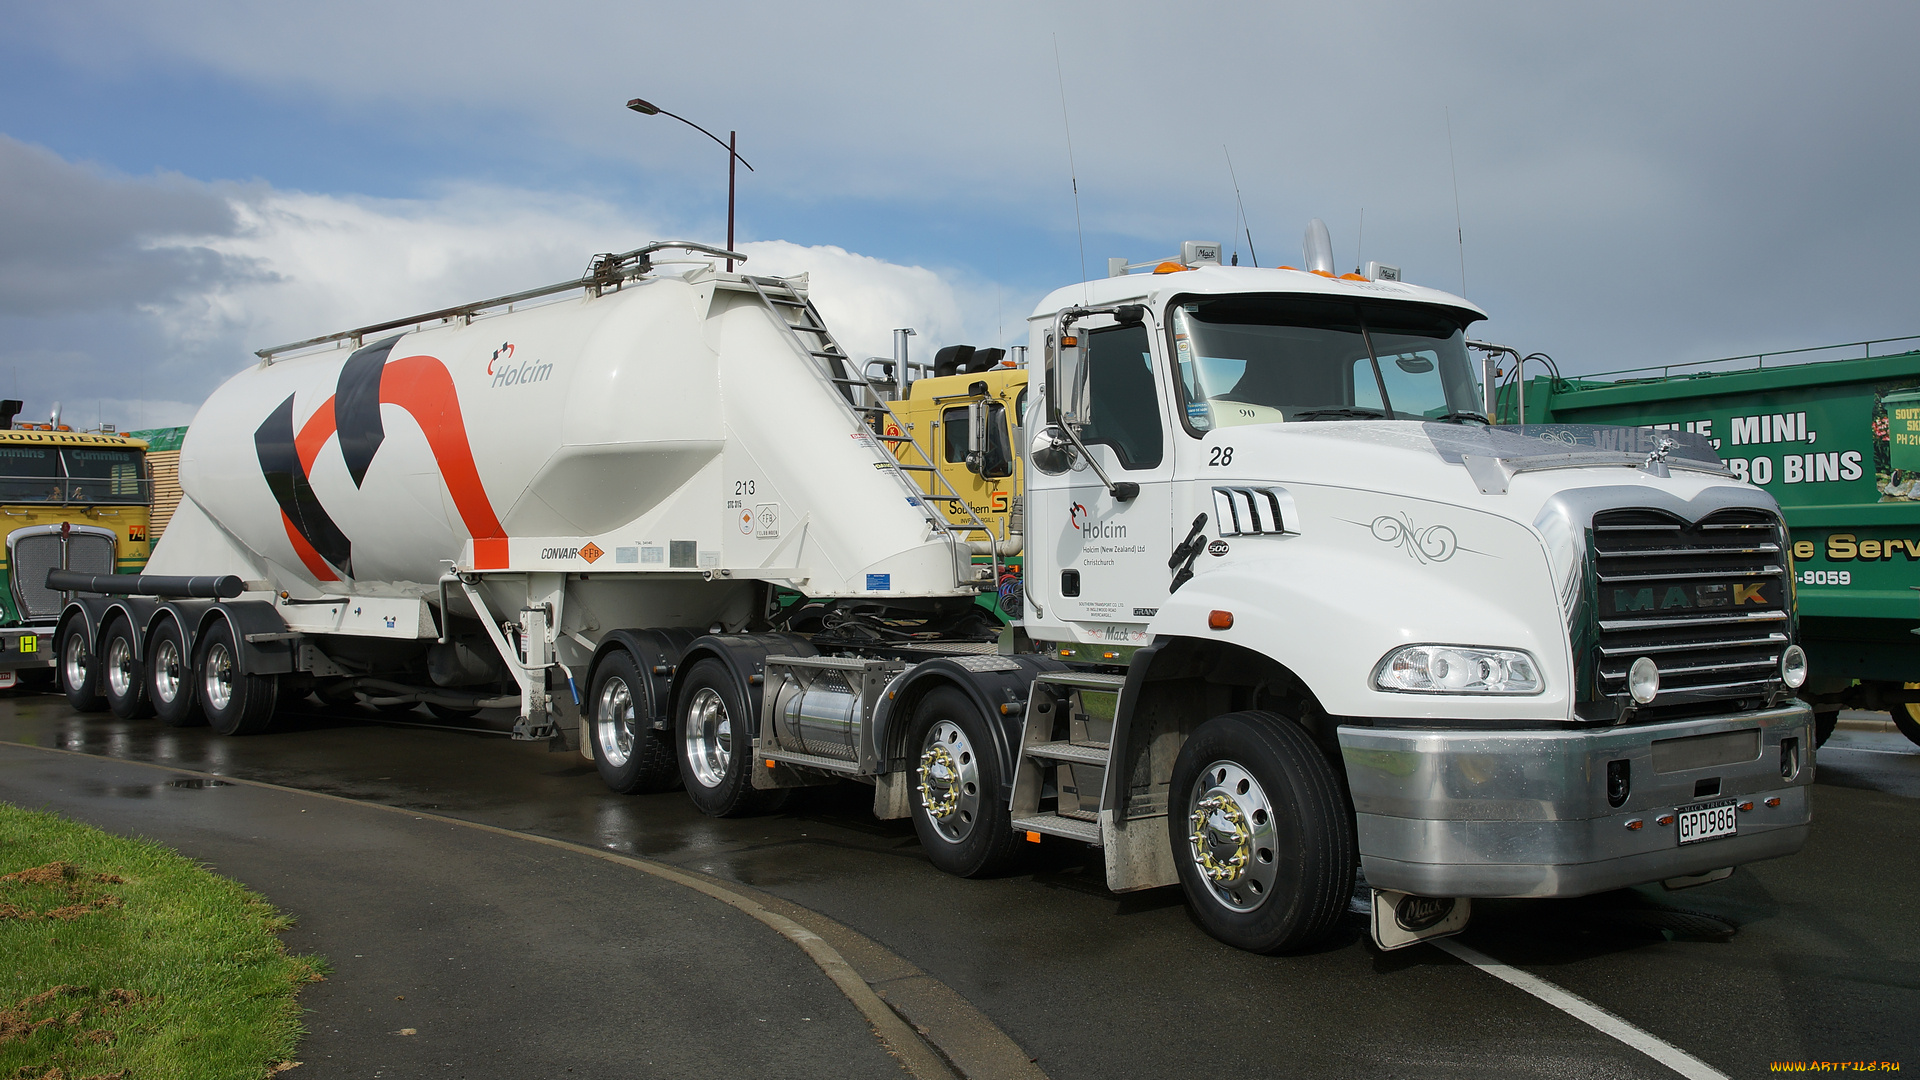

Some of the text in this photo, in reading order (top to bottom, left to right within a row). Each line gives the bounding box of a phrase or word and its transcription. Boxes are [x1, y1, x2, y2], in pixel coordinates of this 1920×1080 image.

[1198, 249, 1215, 258] Mack
[491, 359, 553, 388] Holcim
[1239, 409, 1255, 418] 90
[1896, 408, 1920, 420] SOUT
[1731, 411, 1816, 445] MINI,
[1897, 434, 1908, 445] PH
[0, 448, 45, 459] mmins
[72, 450, 130, 461] Cummins
[1209, 446, 1234, 466] 28
[1783, 450, 1863, 484] BINS
[735, 480, 755, 495] 213
[131, 528, 144, 540] 74
[1083, 521, 1127, 538] Holcim
[541, 547, 578, 559] CONVAIR
[583, 548, 599, 558] FFB
[1100, 546, 1113, 554] (New
[1114, 545, 1136, 554] Zealand)
[1137, 545, 1145, 553] Ltd
[1614, 582, 1768, 612] MACK
[1105, 626, 1129, 641] Mack
[24, 637, 33, 651] H
[1681, 808, 1733, 837] GPD986
[1406, 899, 1441, 920] Mack
